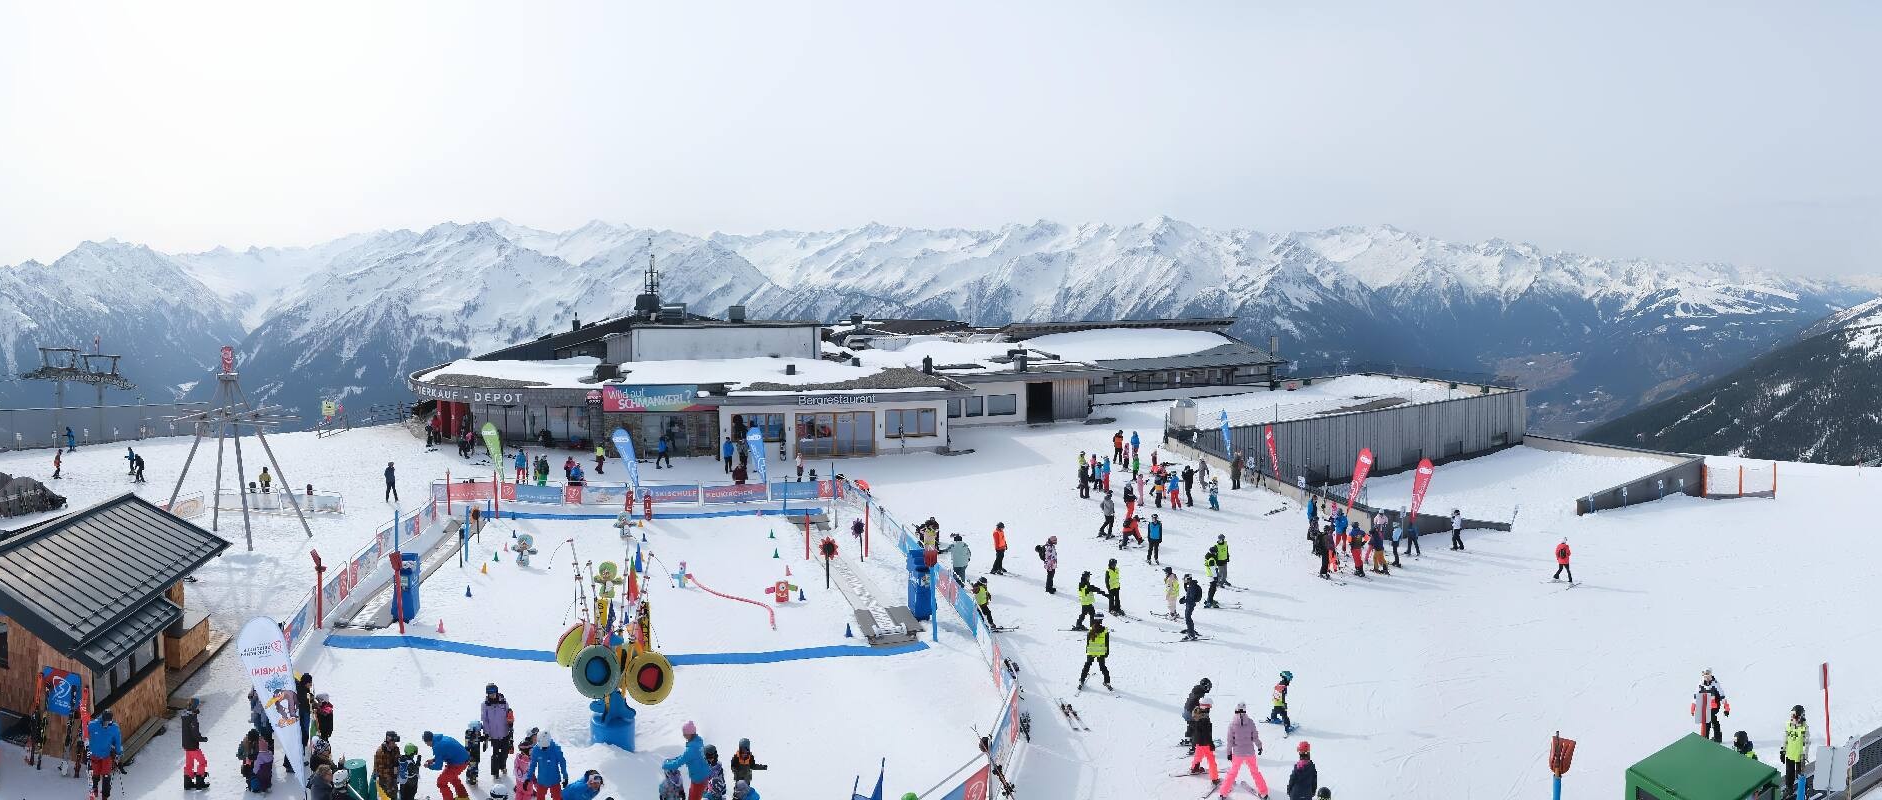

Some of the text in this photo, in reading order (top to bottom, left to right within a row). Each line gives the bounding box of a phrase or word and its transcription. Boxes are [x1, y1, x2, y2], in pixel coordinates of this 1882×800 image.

[417, 386, 458, 399] VERKAUF
[475, 392, 523, 403] DEPOT
[798, 394, 875, 405] Bergrestaurant
